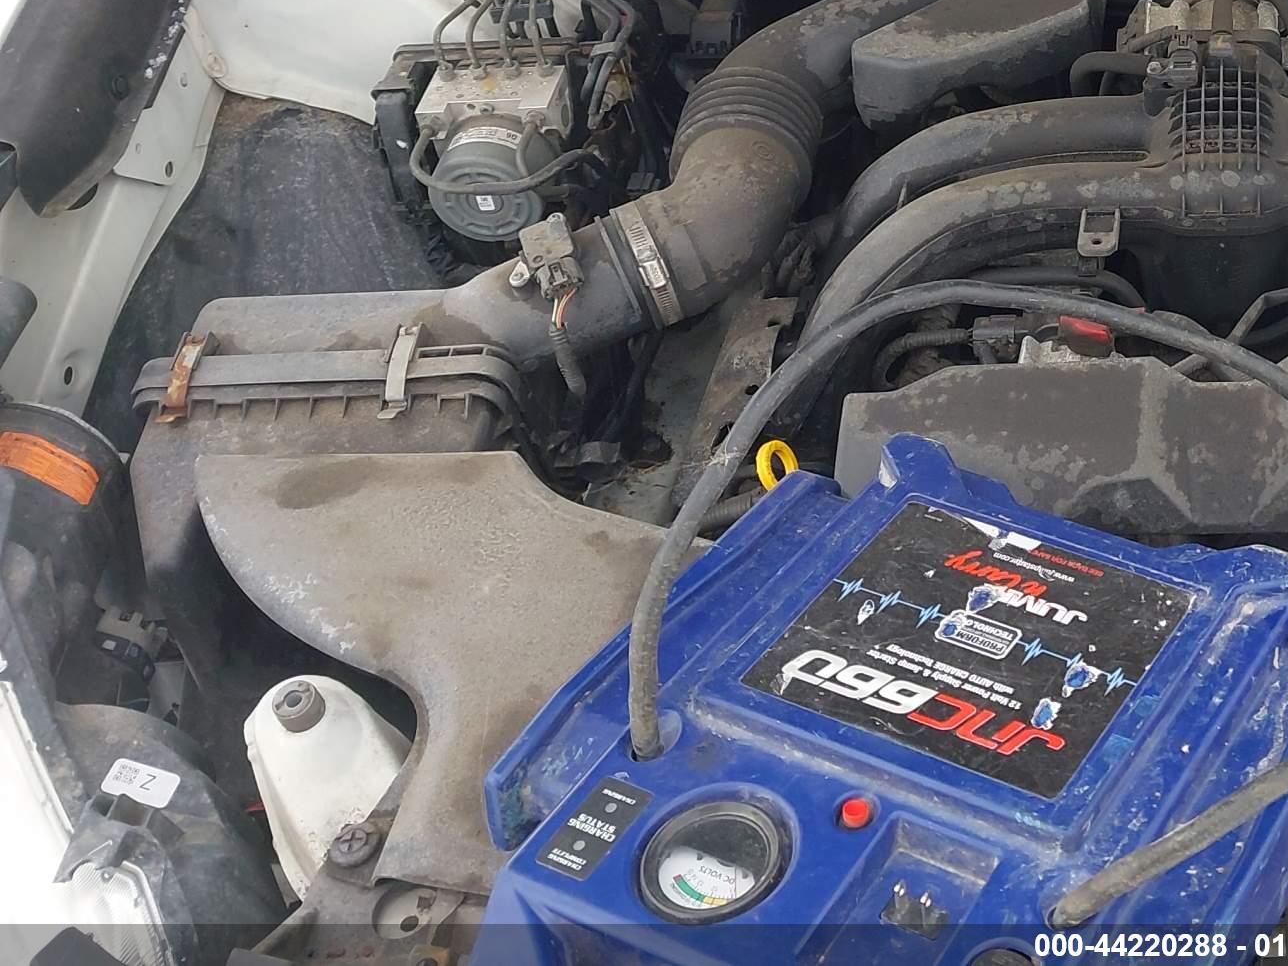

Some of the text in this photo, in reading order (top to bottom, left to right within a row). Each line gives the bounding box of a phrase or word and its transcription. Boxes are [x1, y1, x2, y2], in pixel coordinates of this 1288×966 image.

[866, 647, 1022, 709] 12 Volt Power Supply & Jump Starter
[885, 643, 1014, 695] with AUTO CHARGE Technology
[139, 773, 158, 792] Z
[601, 788, 636, 805] CHARGING
[567, 817, 616, 843] CHARGING
[577, 812, 616, 833] STATUS
[547, 853, 582, 870] CHARGING
[552, 848, 589, 866] COMPLETE
[698, 864, 721, 879] VOLTS
